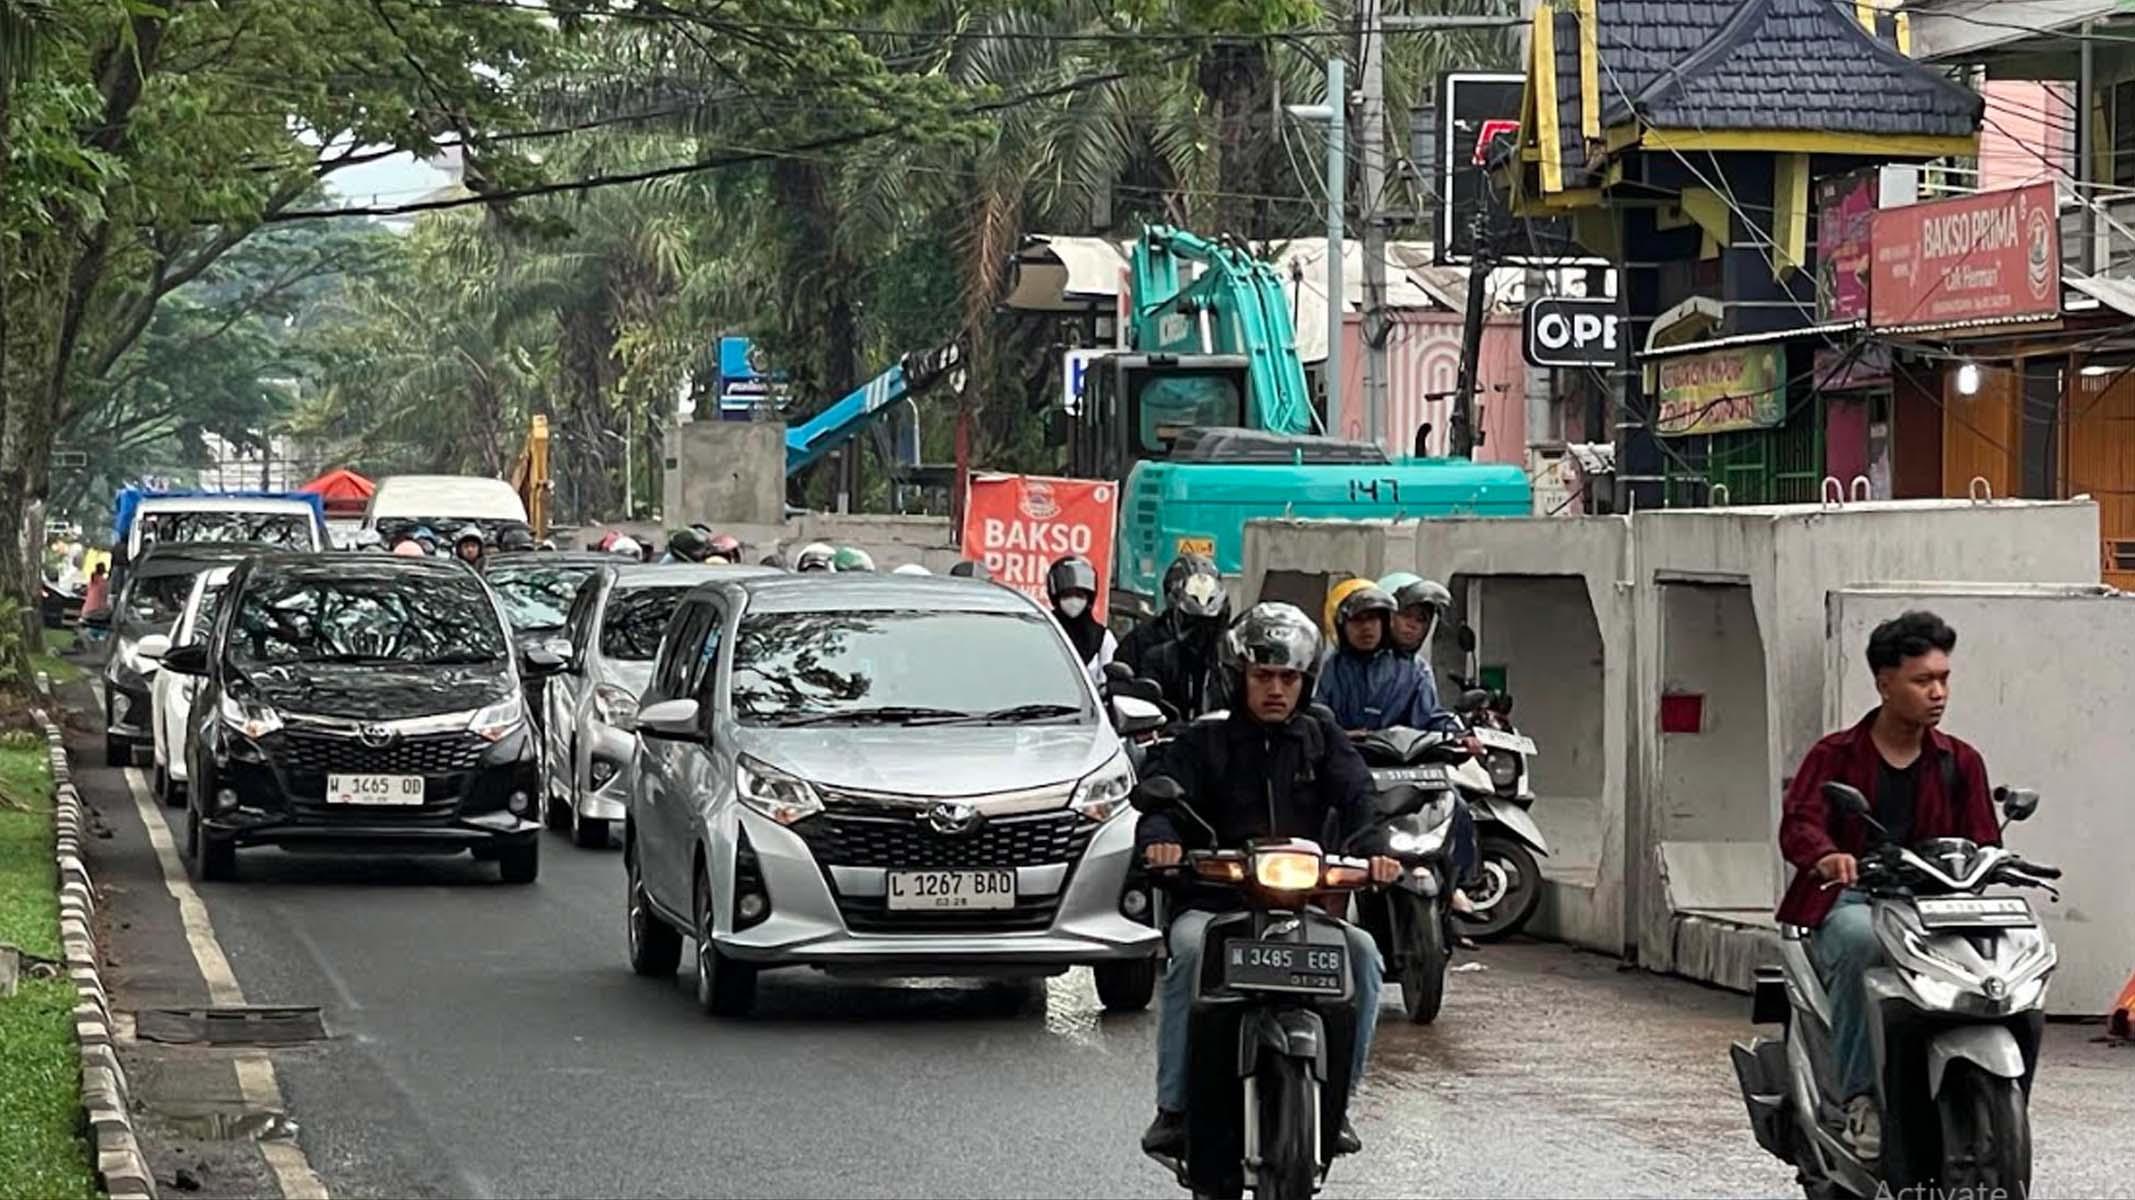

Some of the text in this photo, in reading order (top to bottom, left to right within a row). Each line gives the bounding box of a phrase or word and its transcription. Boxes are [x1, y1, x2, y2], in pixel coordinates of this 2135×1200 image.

[1923, 212, 1970, 260] BAKSO
[1972, 205, 2019, 254] PRIMA
[1349, 479, 1399, 503] 147
[984, 518, 1091, 554] BAKSO
[330, 778, 339, 793] W
[352, 778, 389, 794] 1465
[892, 873, 1011, 897] L 1267 BAO
[1250, 949, 1293, 968] 3485
[1307, 951, 1340, 969] ECB
